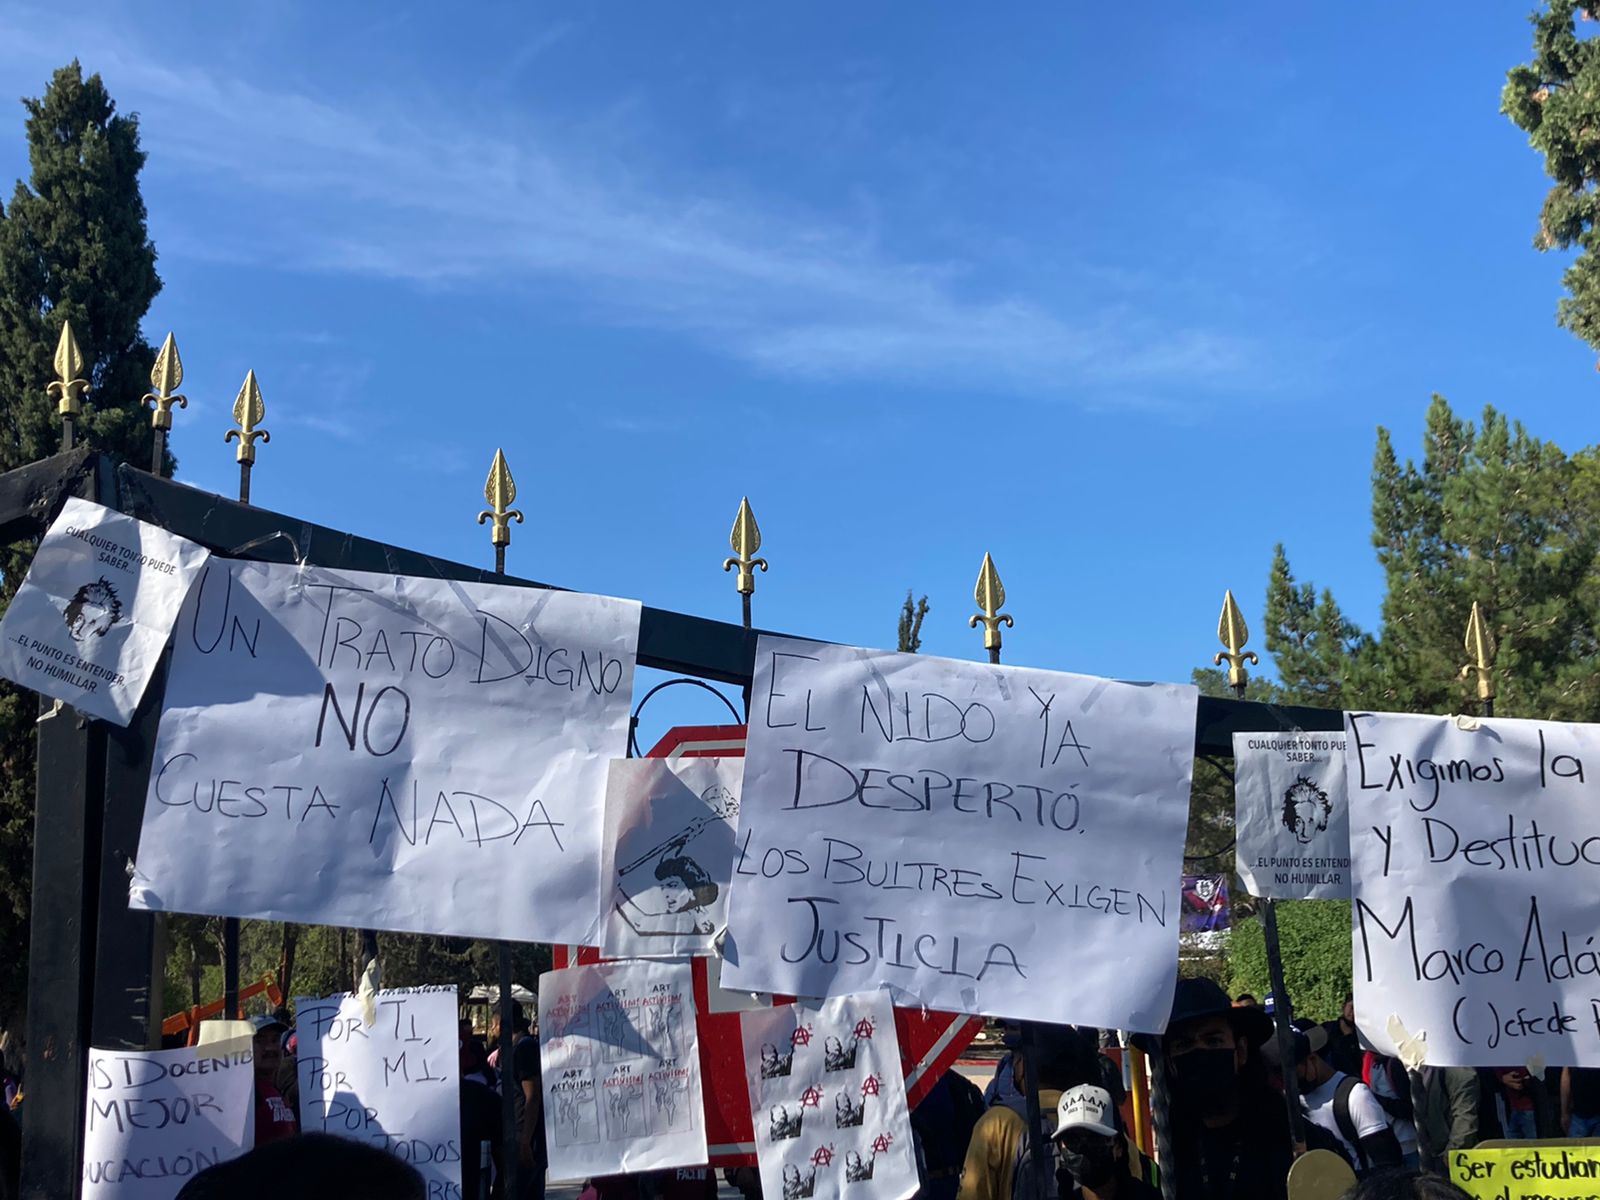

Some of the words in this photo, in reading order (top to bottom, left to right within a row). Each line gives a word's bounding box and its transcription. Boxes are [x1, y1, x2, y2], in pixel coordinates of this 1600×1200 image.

[66, 526, 122, 553] CUALQUIER
[148, 558, 177, 576] PUEDE
[98, 552, 135, 575] SABER...
[31, 640, 62, 660] PUNTO
[62, 653, 75, 666] ES
[308, 584, 455, 680] TRATO
[470, 609, 623, 695] DIGNO
[27, 656, 43, 670] NO
[315, 682, 410, 757] NO
[766, 651, 827, 732] EL
[861, 685, 996, 744] NIDO
[1028, 686, 1091, 769] YA
[1248, 740, 1298, 751] CUALQUIER
[1300, 740, 1329, 751] TONTO
[1286, 752, 1323, 762] SABER...
[1348, 713, 1504, 812] Exigimos
[1538, 729, 1584, 788] la
[155, 753, 340, 820] CUESTA
[369, 778, 564, 852] NADA
[736, 828, 810, 879] LOS
[1010, 851, 1167, 927] EXIGEN
[1271, 857, 1300, 868] PUNTO
[1303, 858, 1313, 867] ES
[1275, 873, 1289, 884] NO
[780, 897, 1028, 981] JUSTICIA
[1355, 896, 1504, 985] Marco
[1515, 895, 1600, 984] Adá
[607, 988, 628, 999] ART
[652, 983, 672, 993] ART
[297, 1006, 369, 1042] POR
[297, 1056, 353, 1090] POR
[563, 1069, 584, 1079] ART
[612, 1064, 632, 1075] ART
[658, 1058, 677, 1068] ART
[90, 1092, 224, 1133] MEJOR
[308, 1100, 379, 1133] POR
[1062, 1093, 1107, 1112] UAAAN
[82, 1146, 221, 1184] UCACIÓN
[1456, 1153, 1497, 1181] Ser
